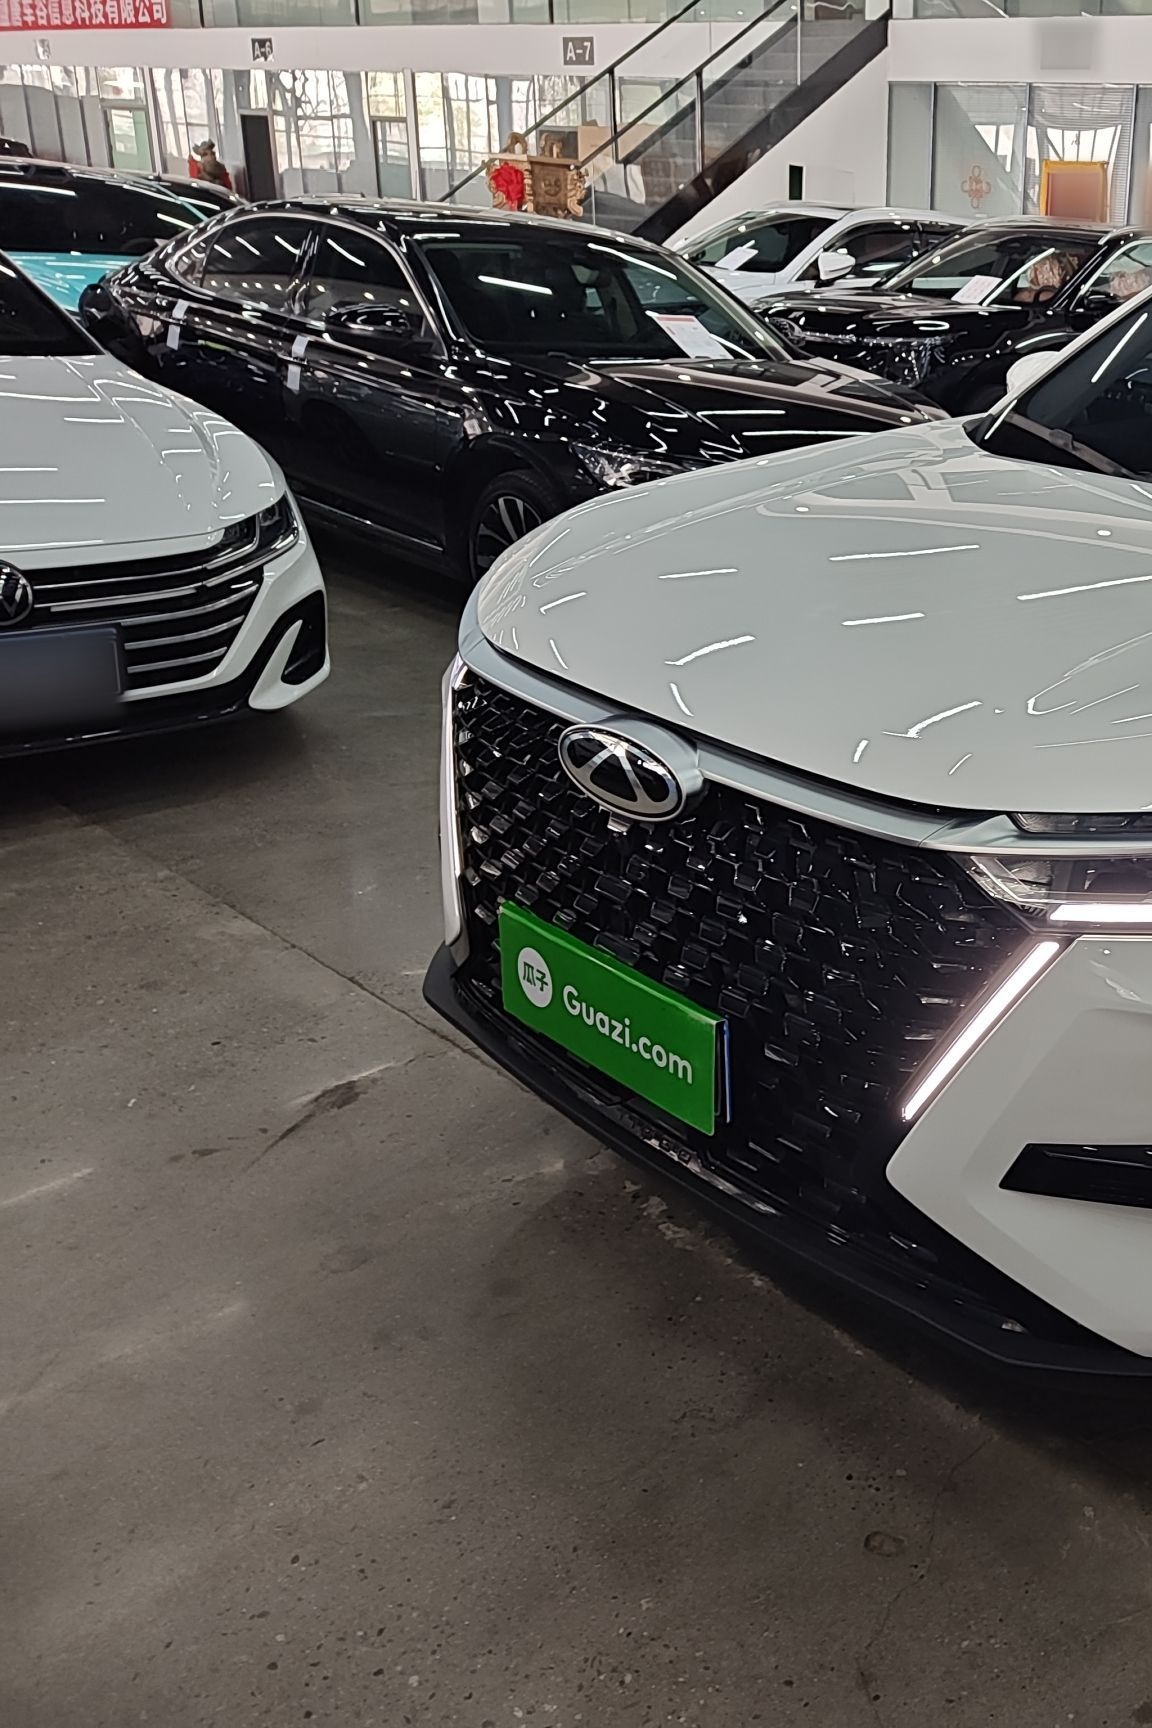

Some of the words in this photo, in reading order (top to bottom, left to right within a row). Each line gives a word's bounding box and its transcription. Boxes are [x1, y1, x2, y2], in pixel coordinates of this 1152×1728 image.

[566, 41, 591, 61] A-7
[522, 961, 549, 992] 瓜子
[562, 984, 694, 1084] Guazi.com
